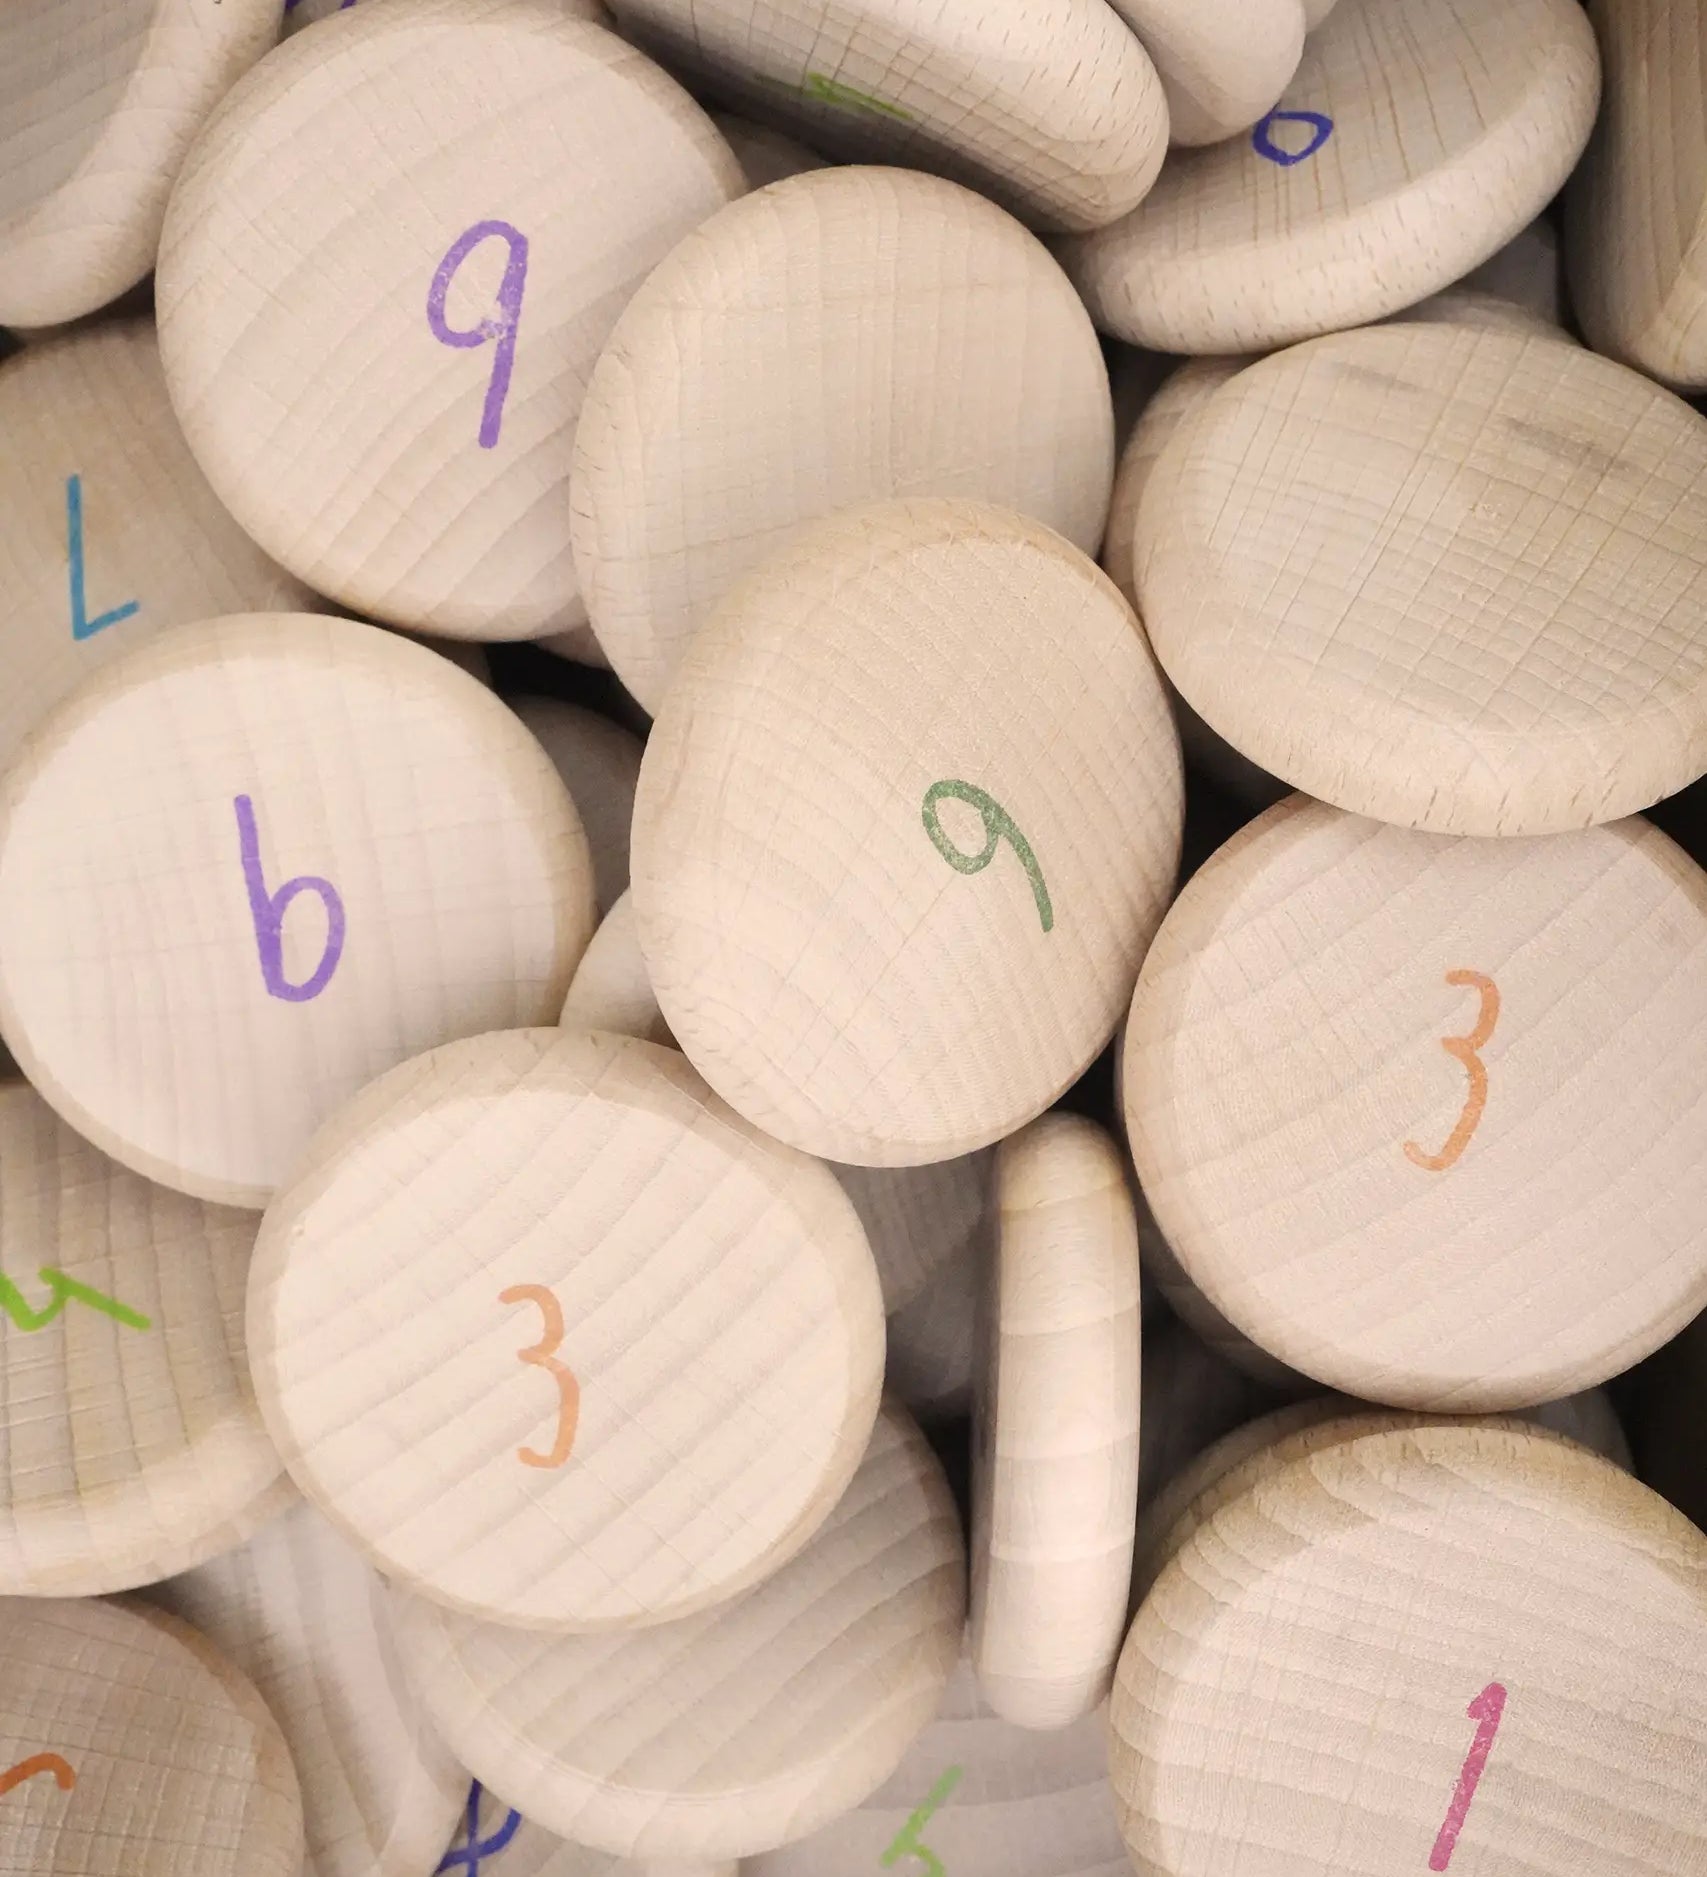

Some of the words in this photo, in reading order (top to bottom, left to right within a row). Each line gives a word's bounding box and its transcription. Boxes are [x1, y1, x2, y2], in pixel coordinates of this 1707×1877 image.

[427, 218, 529, 449] 9
[1402, 967, 1501, 1173] 3
[499, 1283, 581, 1469] 3
[1428, 1681, 1508, 1872] 1
